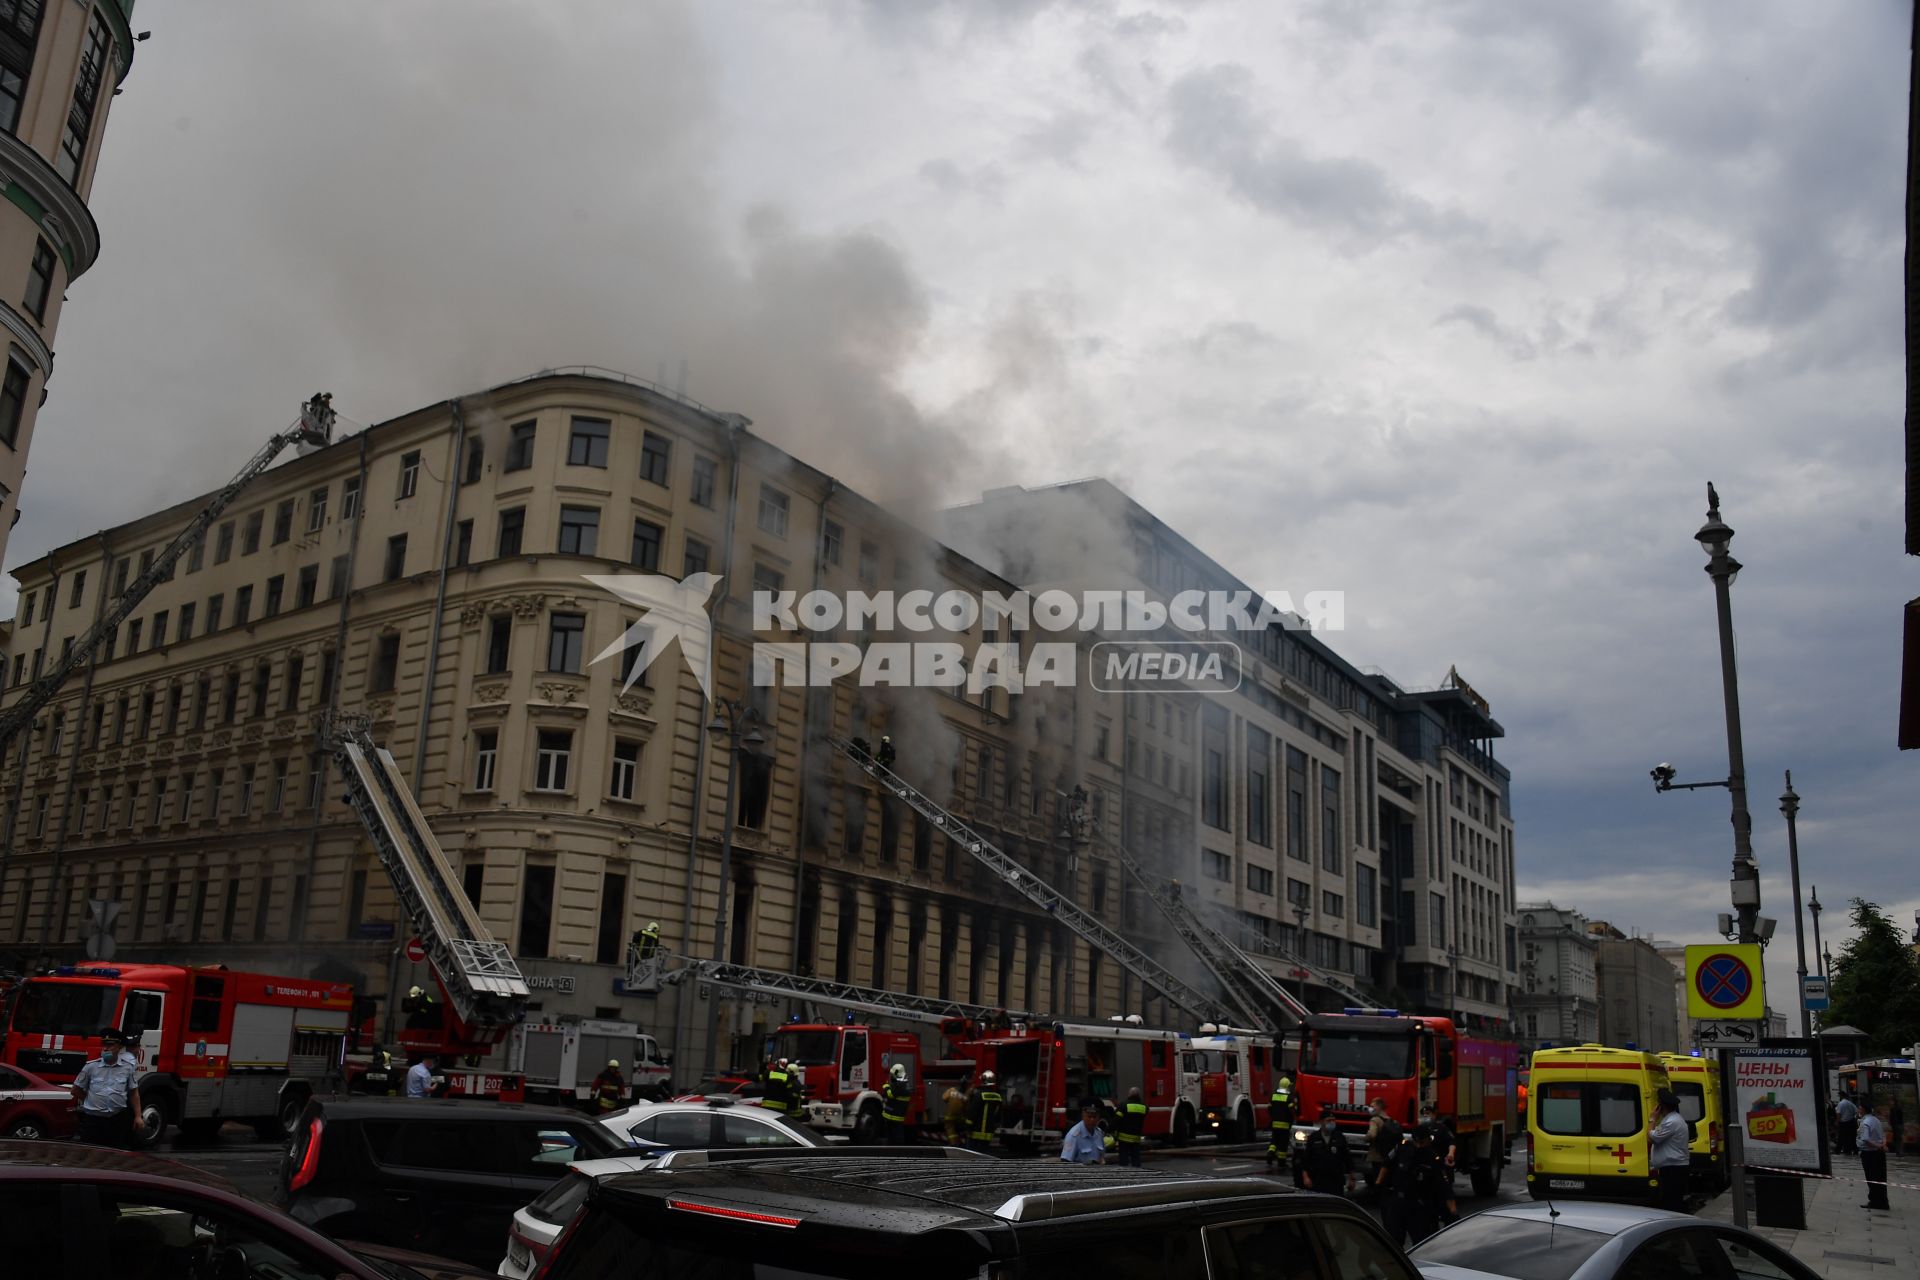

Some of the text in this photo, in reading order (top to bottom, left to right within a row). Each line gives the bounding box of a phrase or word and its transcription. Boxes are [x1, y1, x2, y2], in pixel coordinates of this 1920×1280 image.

[1737, 1062, 1790, 1076] ЦЕНЫ
[1736, 1078, 1804, 1088] ПОПОЛАМ
[1332, 1103, 1370, 1113] IVECO
